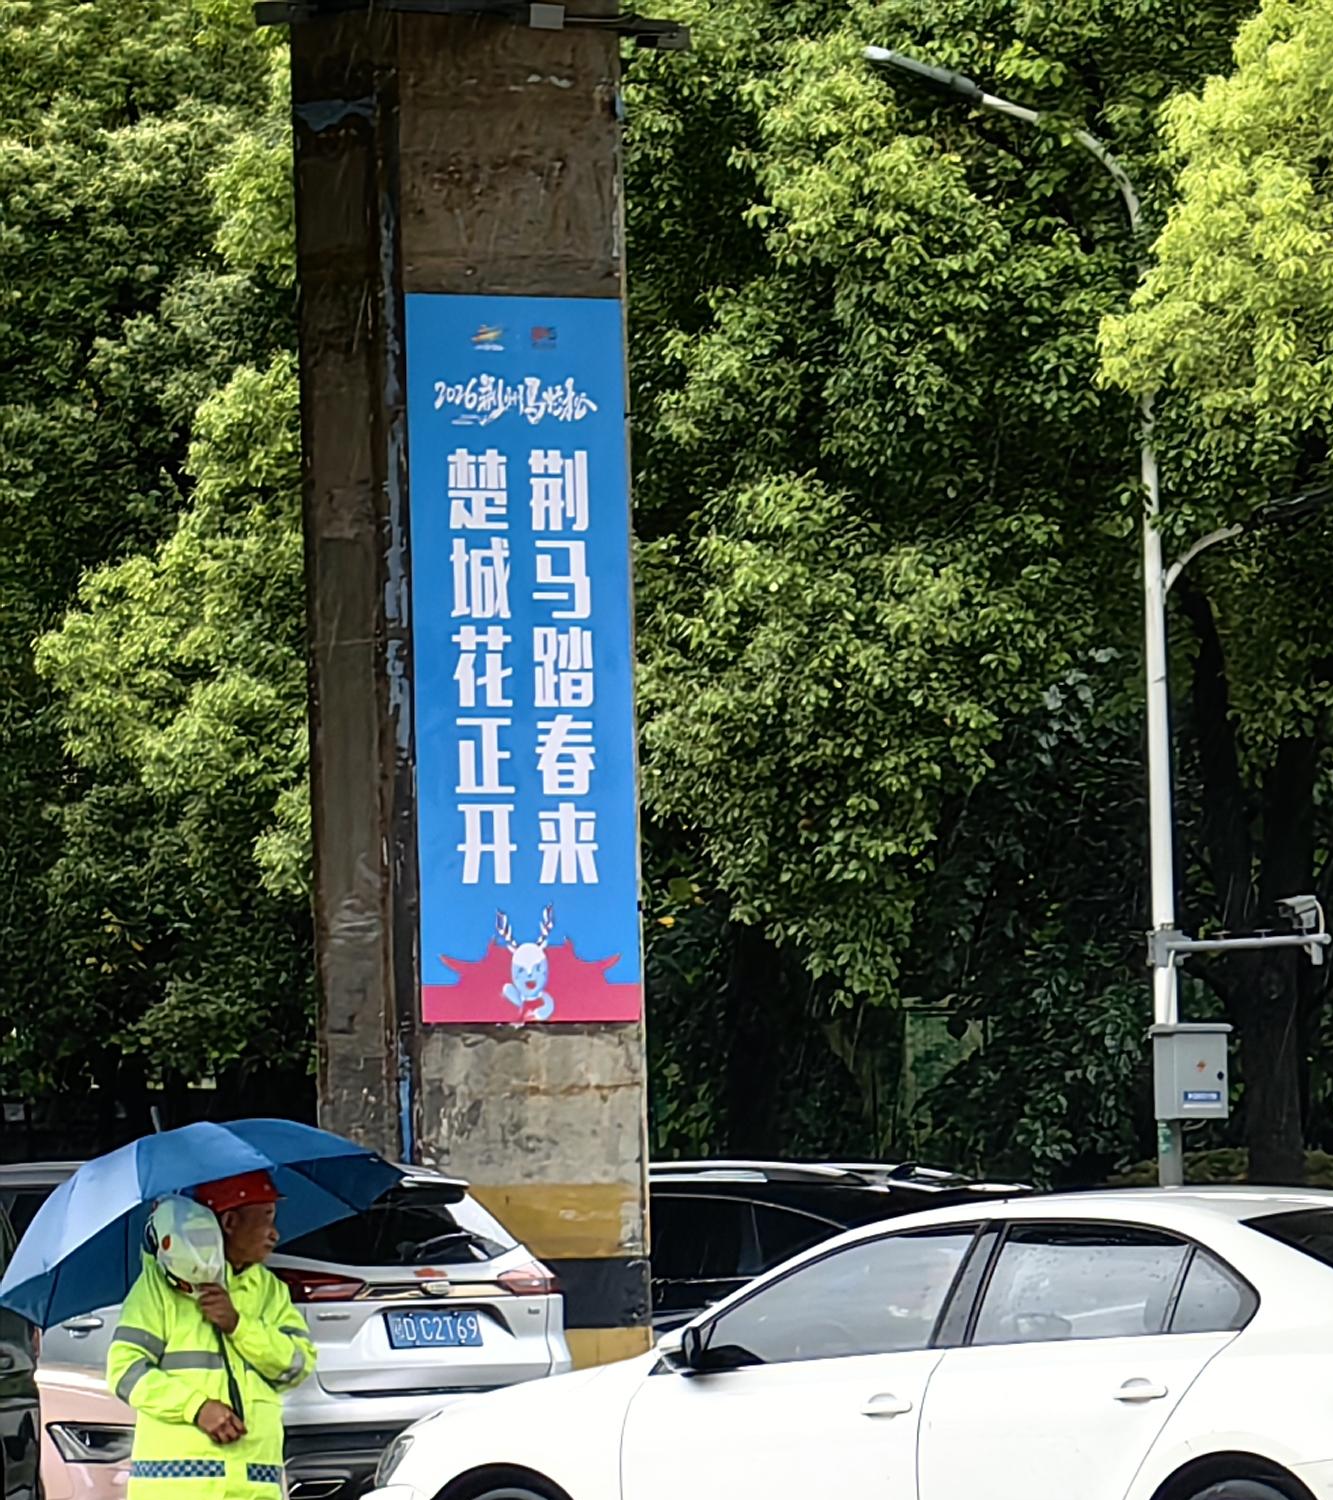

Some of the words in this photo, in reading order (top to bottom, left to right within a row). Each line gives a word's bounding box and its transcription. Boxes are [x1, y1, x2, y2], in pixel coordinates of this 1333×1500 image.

[447, 447, 518, 884] 楚城花正开
[528, 449, 599, 884] 荆马踏春来
